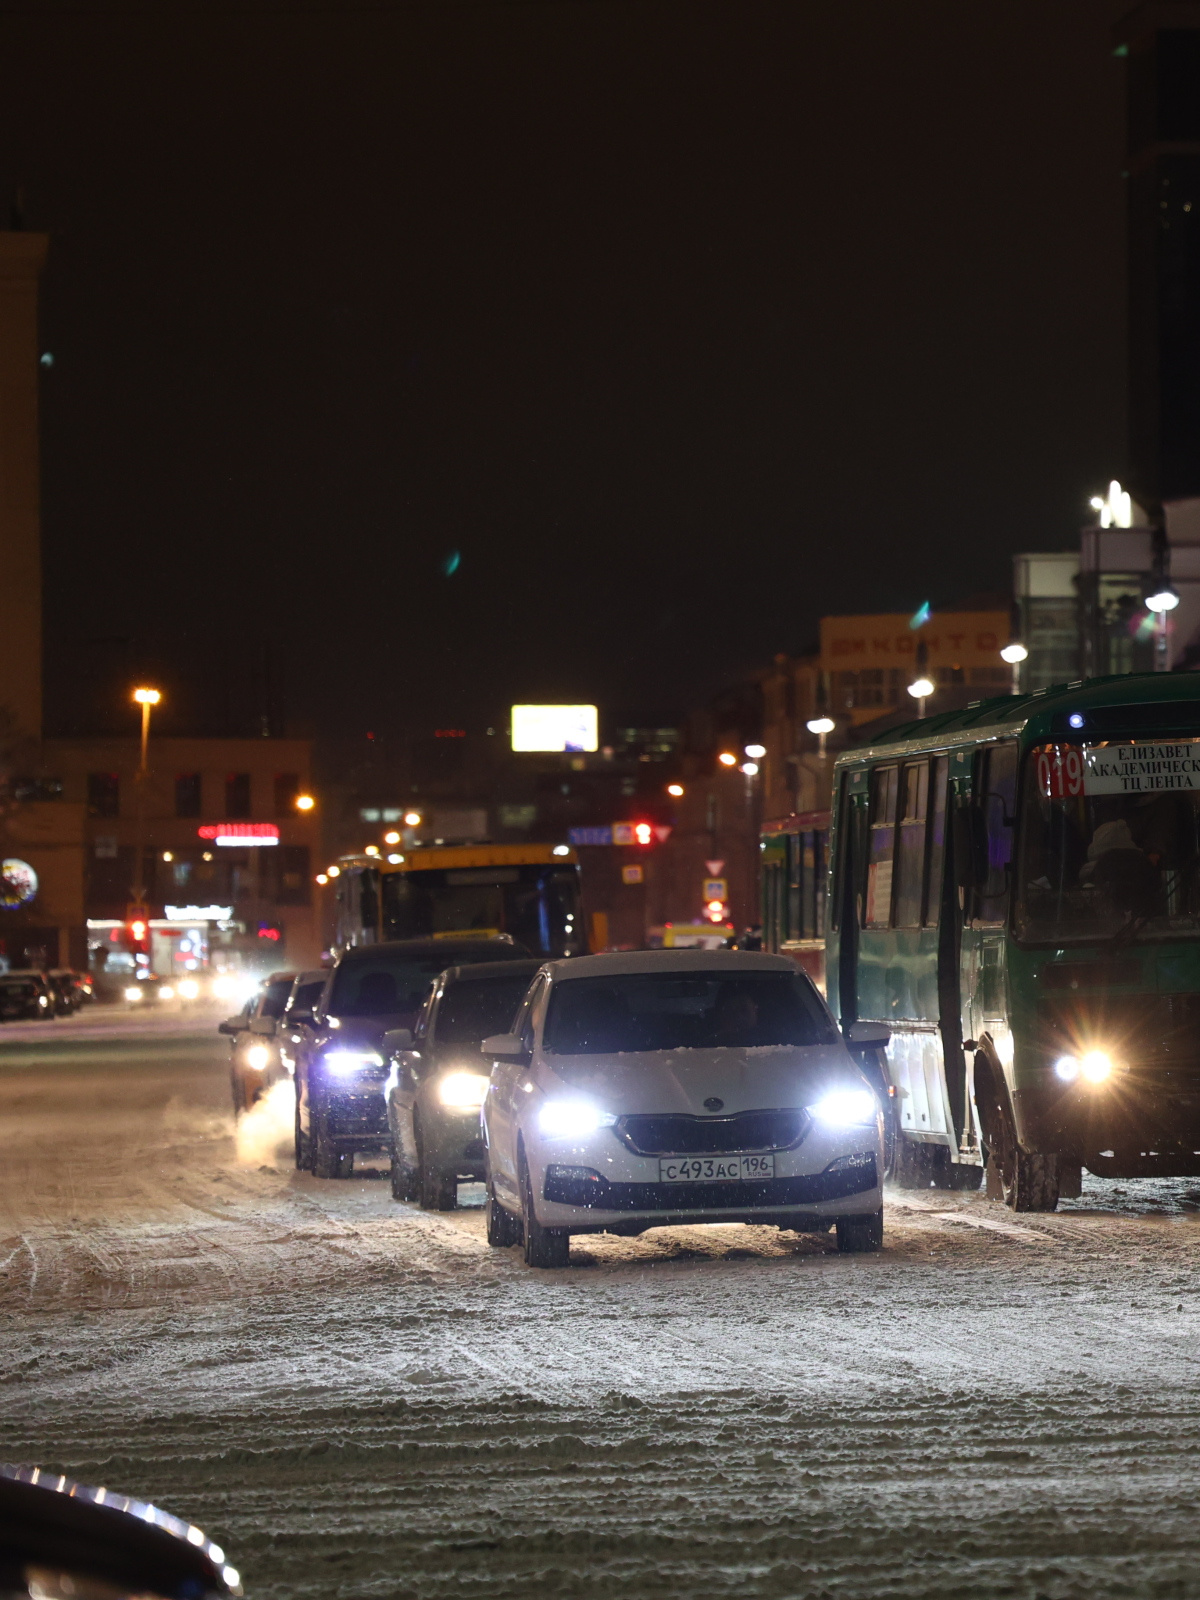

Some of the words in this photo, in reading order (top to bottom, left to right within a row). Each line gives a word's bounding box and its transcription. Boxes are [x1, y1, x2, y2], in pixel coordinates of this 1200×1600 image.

[1118, 745, 1193, 761] ЕЛИЗАВЕТ
[1038, 751, 1083, 797] 019
[1121, 777, 1142, 791] ТЦ
[1144, 775, 1193, 789] ЛЕНТА
[666, 1160, 738, 1179] С493АС
[742, 1157, 769, 1172] 196
